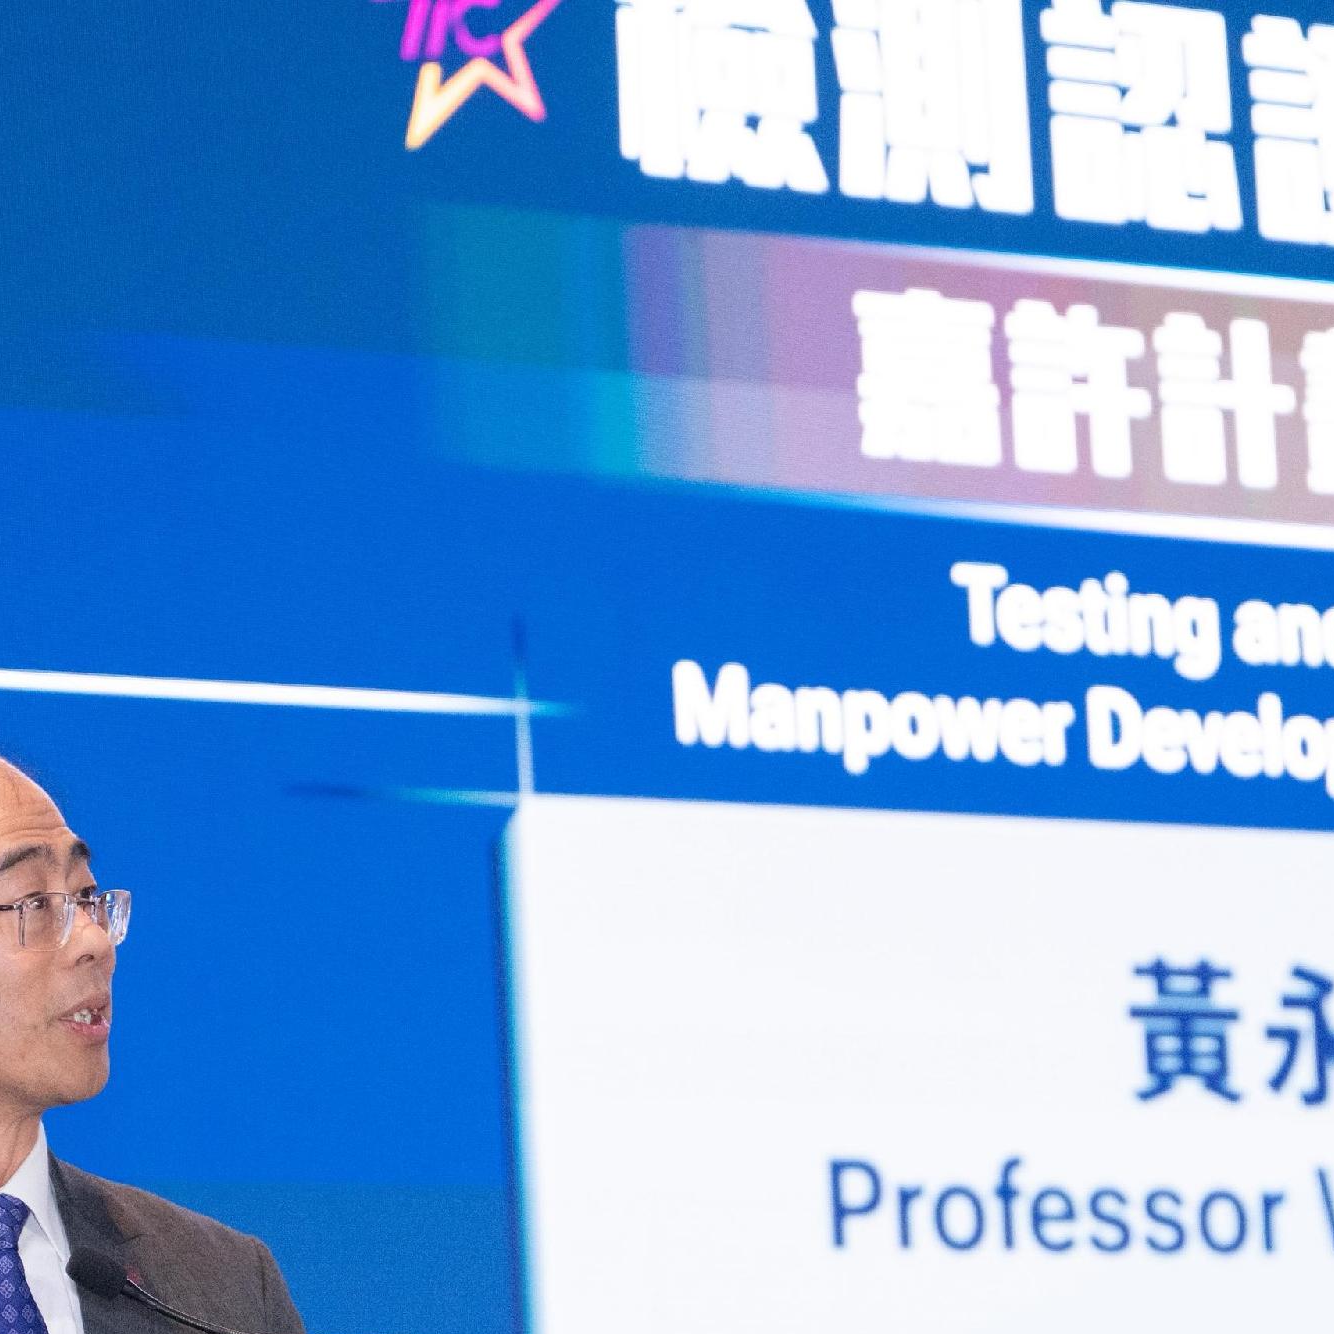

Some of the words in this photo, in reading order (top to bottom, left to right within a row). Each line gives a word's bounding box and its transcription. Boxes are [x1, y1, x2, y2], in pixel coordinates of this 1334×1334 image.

[951, 562, 1221, 680] Testing
[672, 660, 1075, 774] Manpower
[828, 1156, 1286, 1255] Professor
